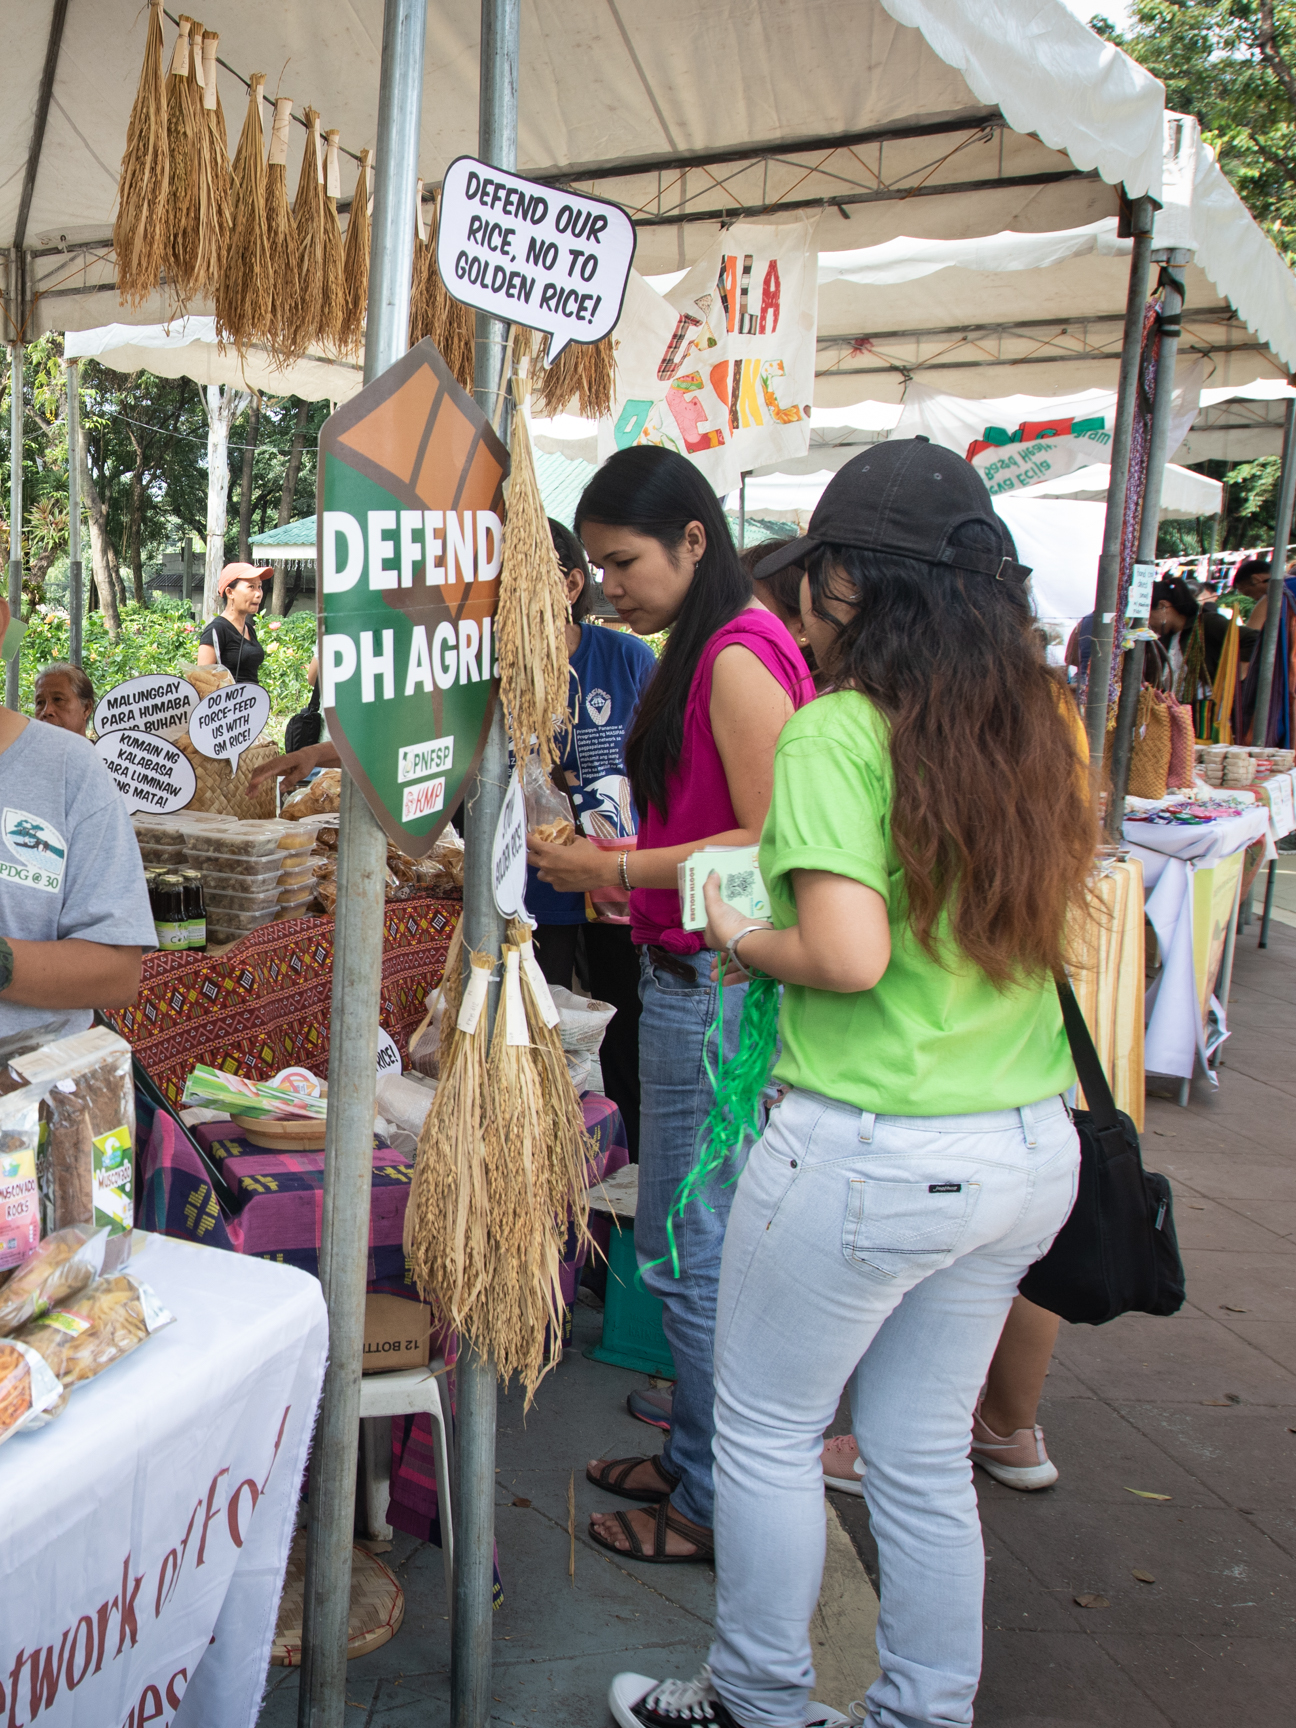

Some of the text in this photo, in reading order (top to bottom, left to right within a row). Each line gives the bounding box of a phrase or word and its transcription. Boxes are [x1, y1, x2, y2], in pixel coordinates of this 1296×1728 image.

[465, 171, 608, 245] DEFEND OUR
[467, 214, 599, 283] RICE, NO TO
[455, 250, 603, 325] GOLDEN RICE!
[322, 510, 502, 593] DEFEND
[322, 629, 396, 709] PH
[107, 681, 181, 711] MALUNGGAY
[207, 686, 247, 709] DO NOT
[101, 711, 136, 729] PARA
[138, 695, 191, 719] HUMABA
[144, 710, 188, 733] BUHAY!
[198, 697, 257, 729] FORCE-FEED
[212, 713, 250, 740] US WITH
[119, 733, 180, 765] KUMAIN NG
[214, 728, 251, 756] GM RICE!
[117, 748, 174, 779] KALABASA
[413, 745, 450, 774] PNFSP
[131, 768, 182, 798] LUMINAW
[132, 786, 168, 809] MATA!
[413, 782, 443, 815] KMP
[32, 872, 42, 884] @
[44, 875, 59, 889] 30
[7, 1200, 29, 1218] ROCKS
[405, 1340, 420, 1350] 12
